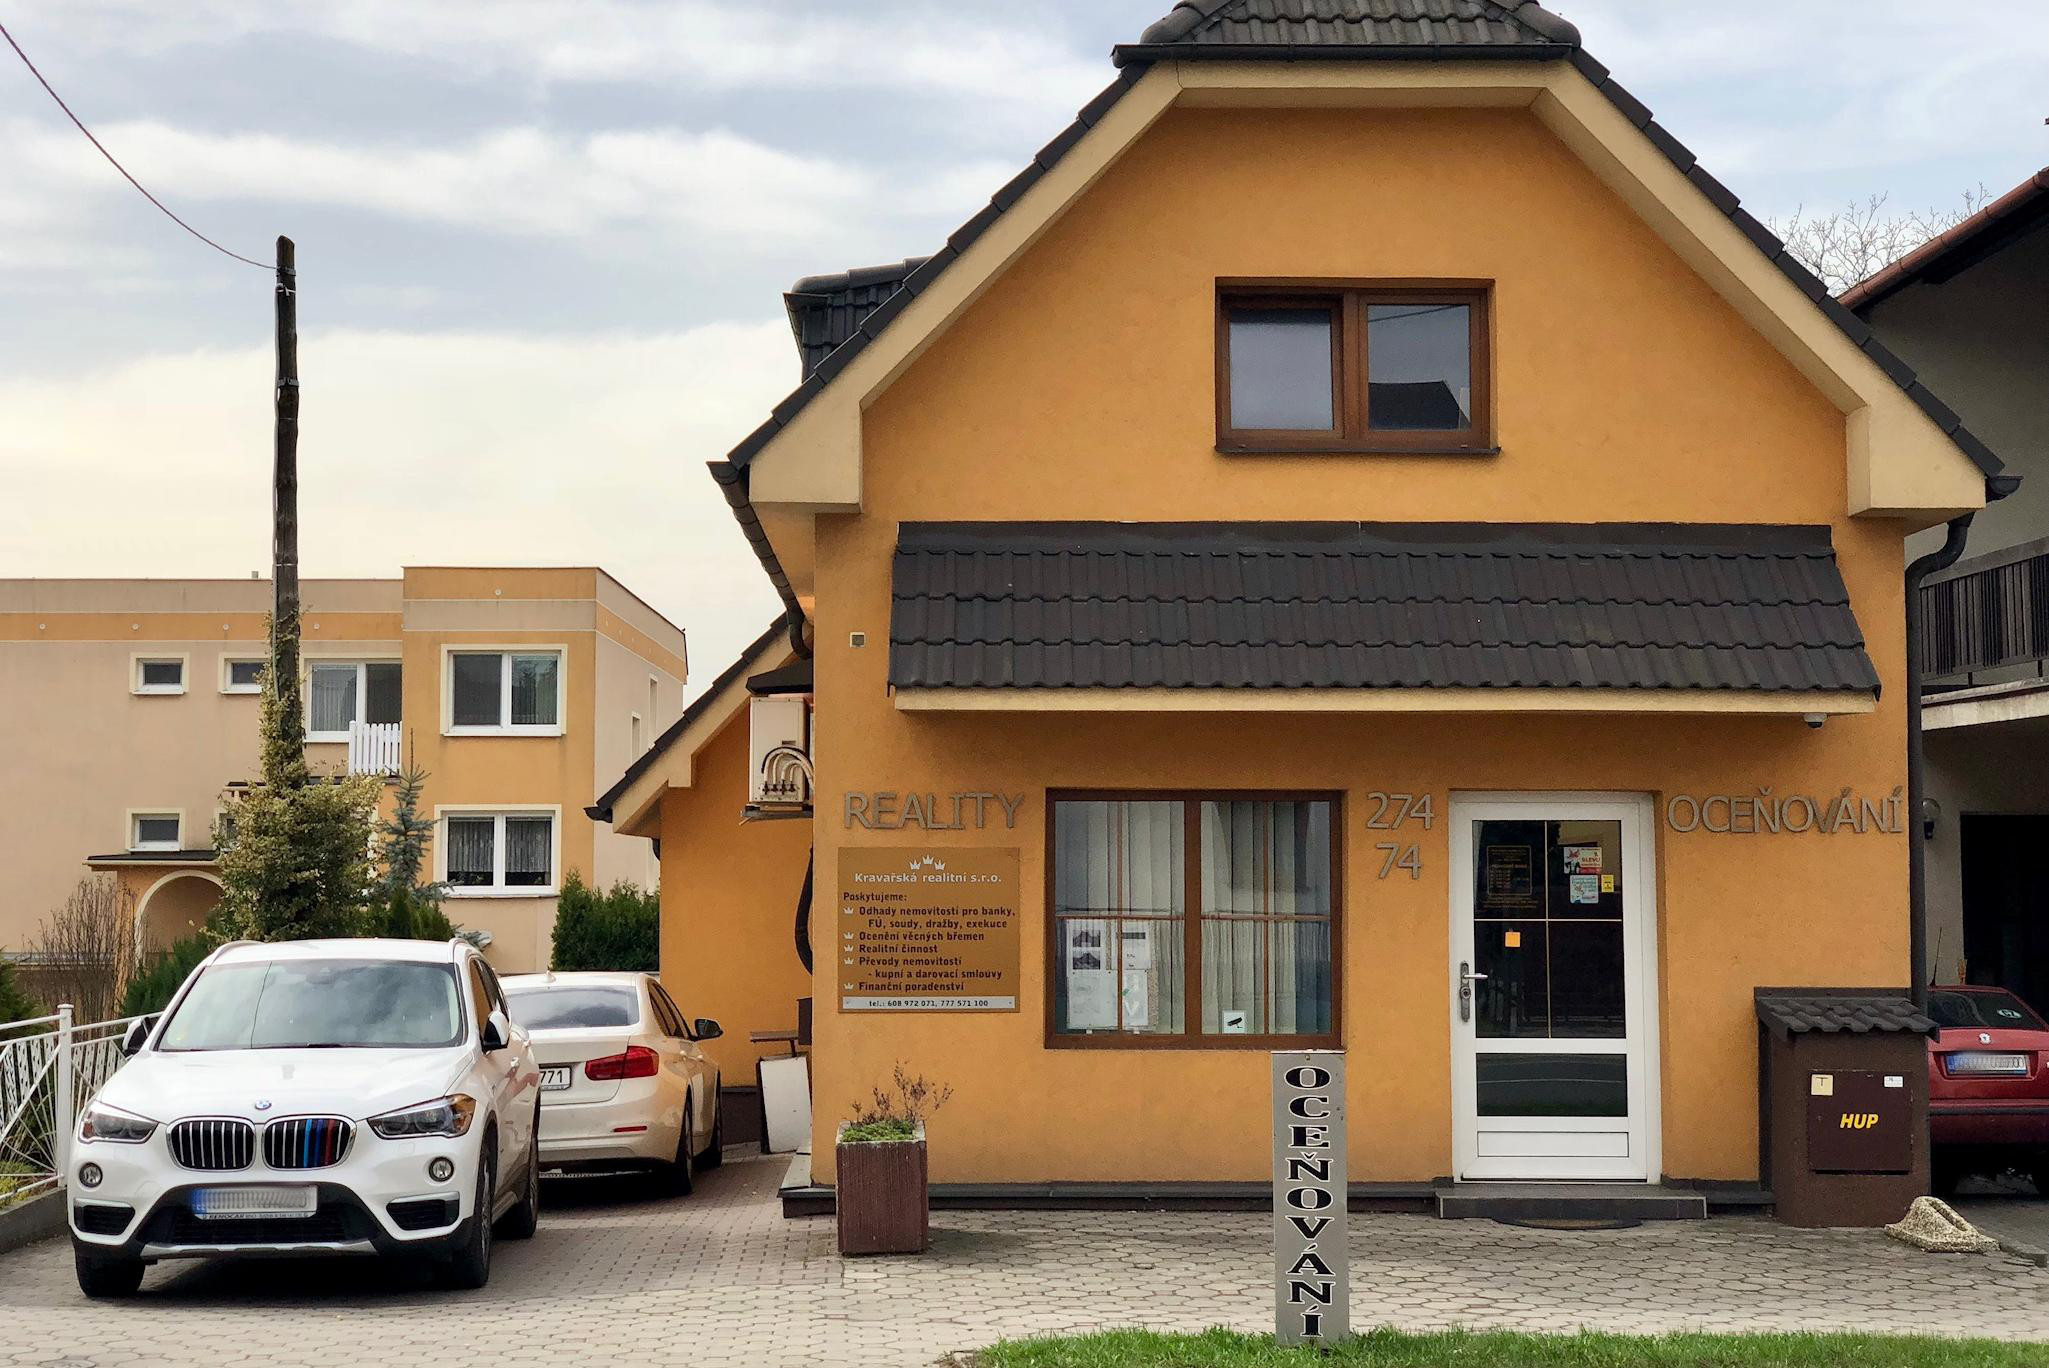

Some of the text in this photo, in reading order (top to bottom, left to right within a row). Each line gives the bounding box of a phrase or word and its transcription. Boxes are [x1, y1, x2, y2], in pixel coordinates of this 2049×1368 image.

[844, 791, 1025, 830] REALITY
[1367, 792, 1435, 830] 274
[1667, 785, 1904, 833] OCEŇOVÁNÍ
[1376, 842, 1422, 880] 74
[855, 872, 1002, 883] Kravařská realitní s.r.o.
[843, 892, 907, 903] Poskytujeme:
[859, 906, 896, 917] Odhady
[962, 908, 978, 917] pro
[982, 906, 1015, 917] banky,
[890, 919, 922, 929] soudy,
[926, 919, 962, 929] dražby,
[966, 919, 1008, 928] exekuce
[859, 931, 984, 942] Ocenění věcných břemen
[859, 943, 938, 953] Realitní činnost
[859, 956, 899, 967] Převody
[875, 969, 903, 980] kupní
[916, 968, 958, 978] darovací
[859, 982, 964, 992] Finanční poradenství
[921, 1000, 937, 1008] 071,
[1840, 1113, 1879, 1129] HUP
[1284, 1065, 1336, 1338] OCEŇOVÁNÍ
